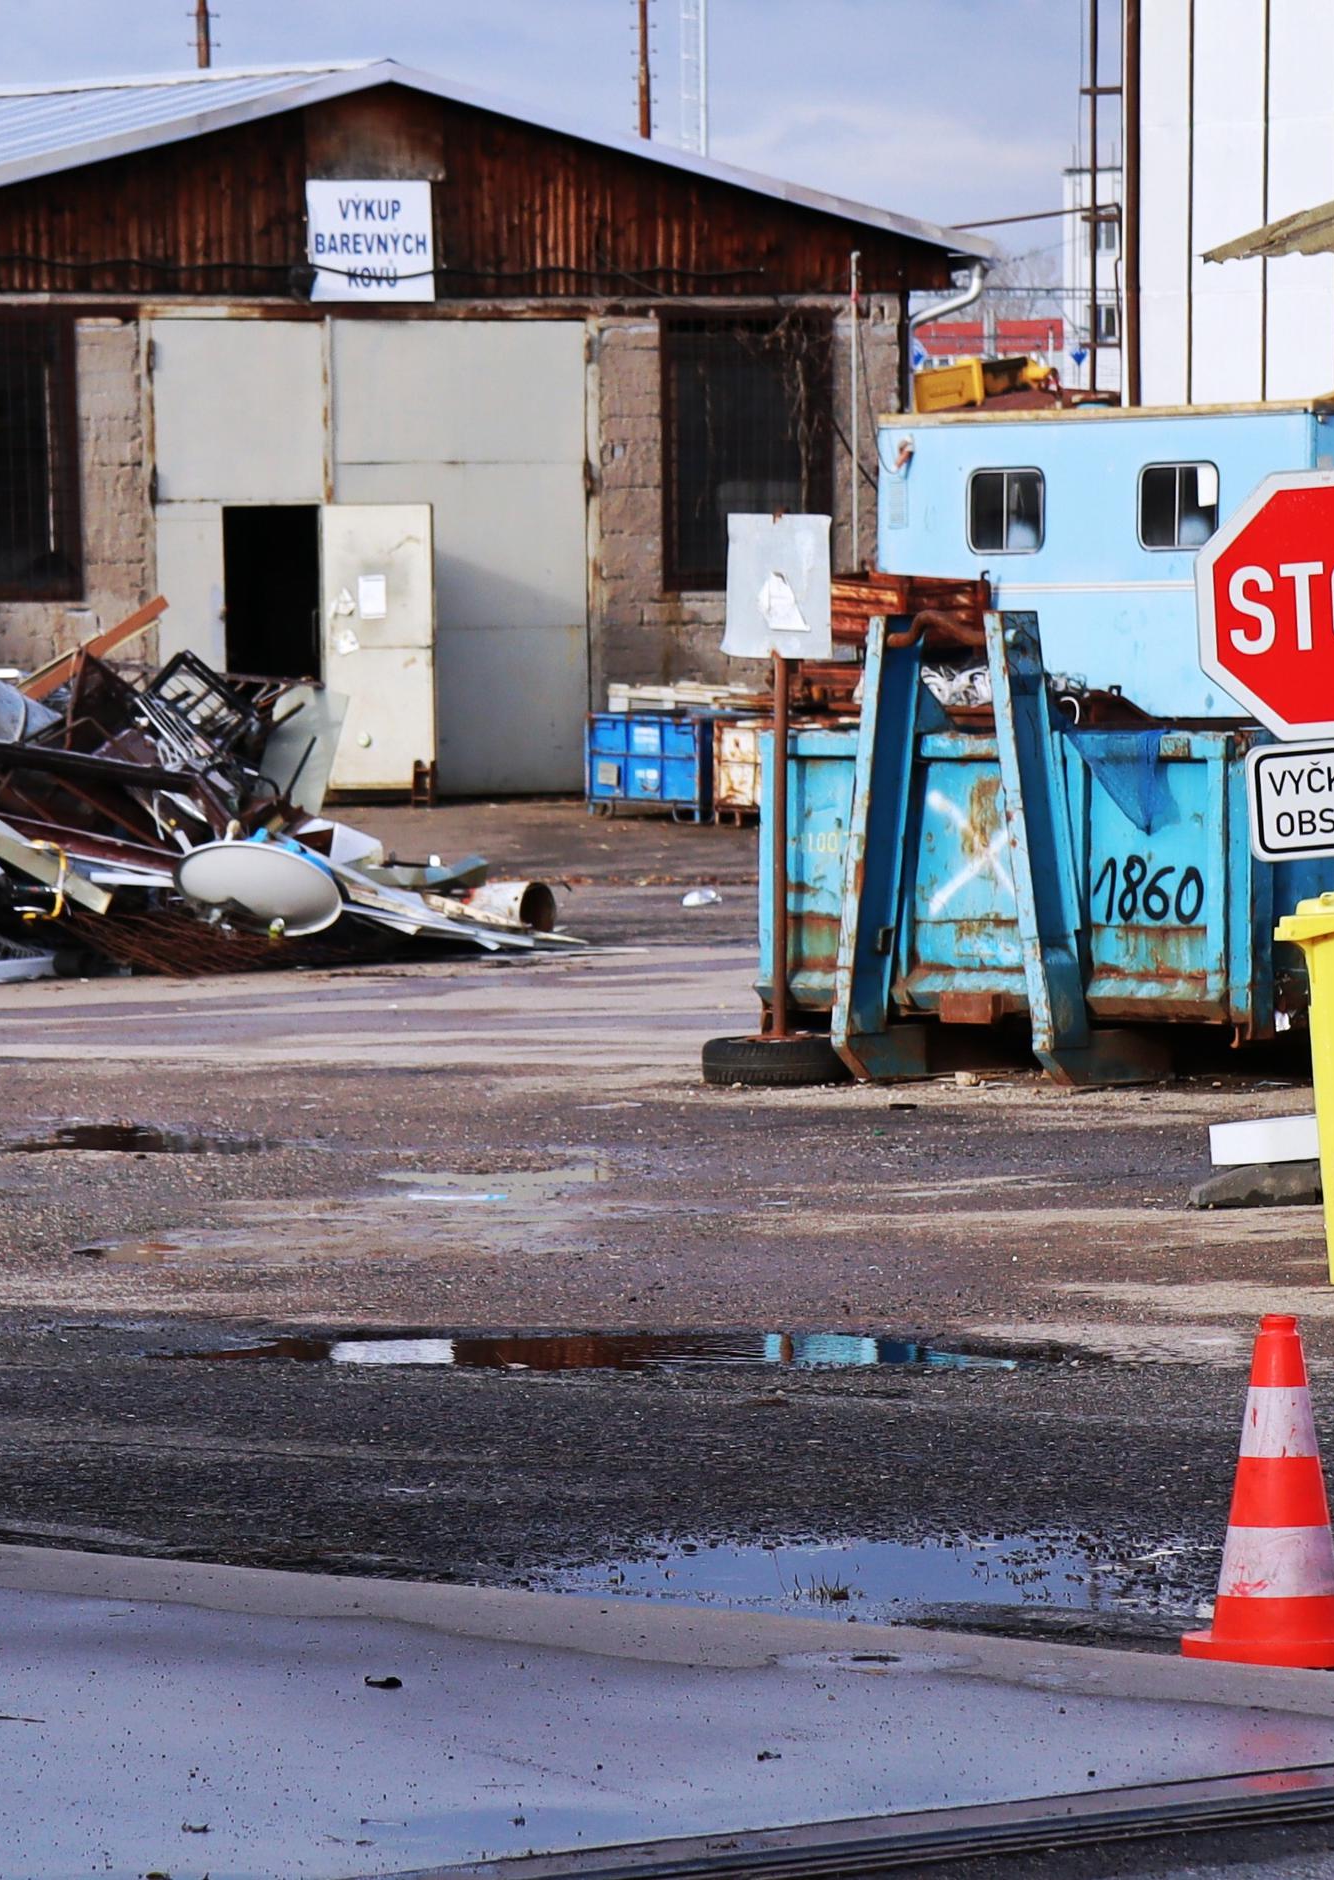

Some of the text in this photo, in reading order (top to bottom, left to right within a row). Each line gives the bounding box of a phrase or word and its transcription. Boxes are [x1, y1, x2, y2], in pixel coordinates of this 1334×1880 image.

[338, 192, 402, 221] VÝKUP
[314, 227, 428, 255] BAREVNÝCH
[346, 258, 398, 288] KOVŮ
[1092, 854, 1204, 925] 1860
